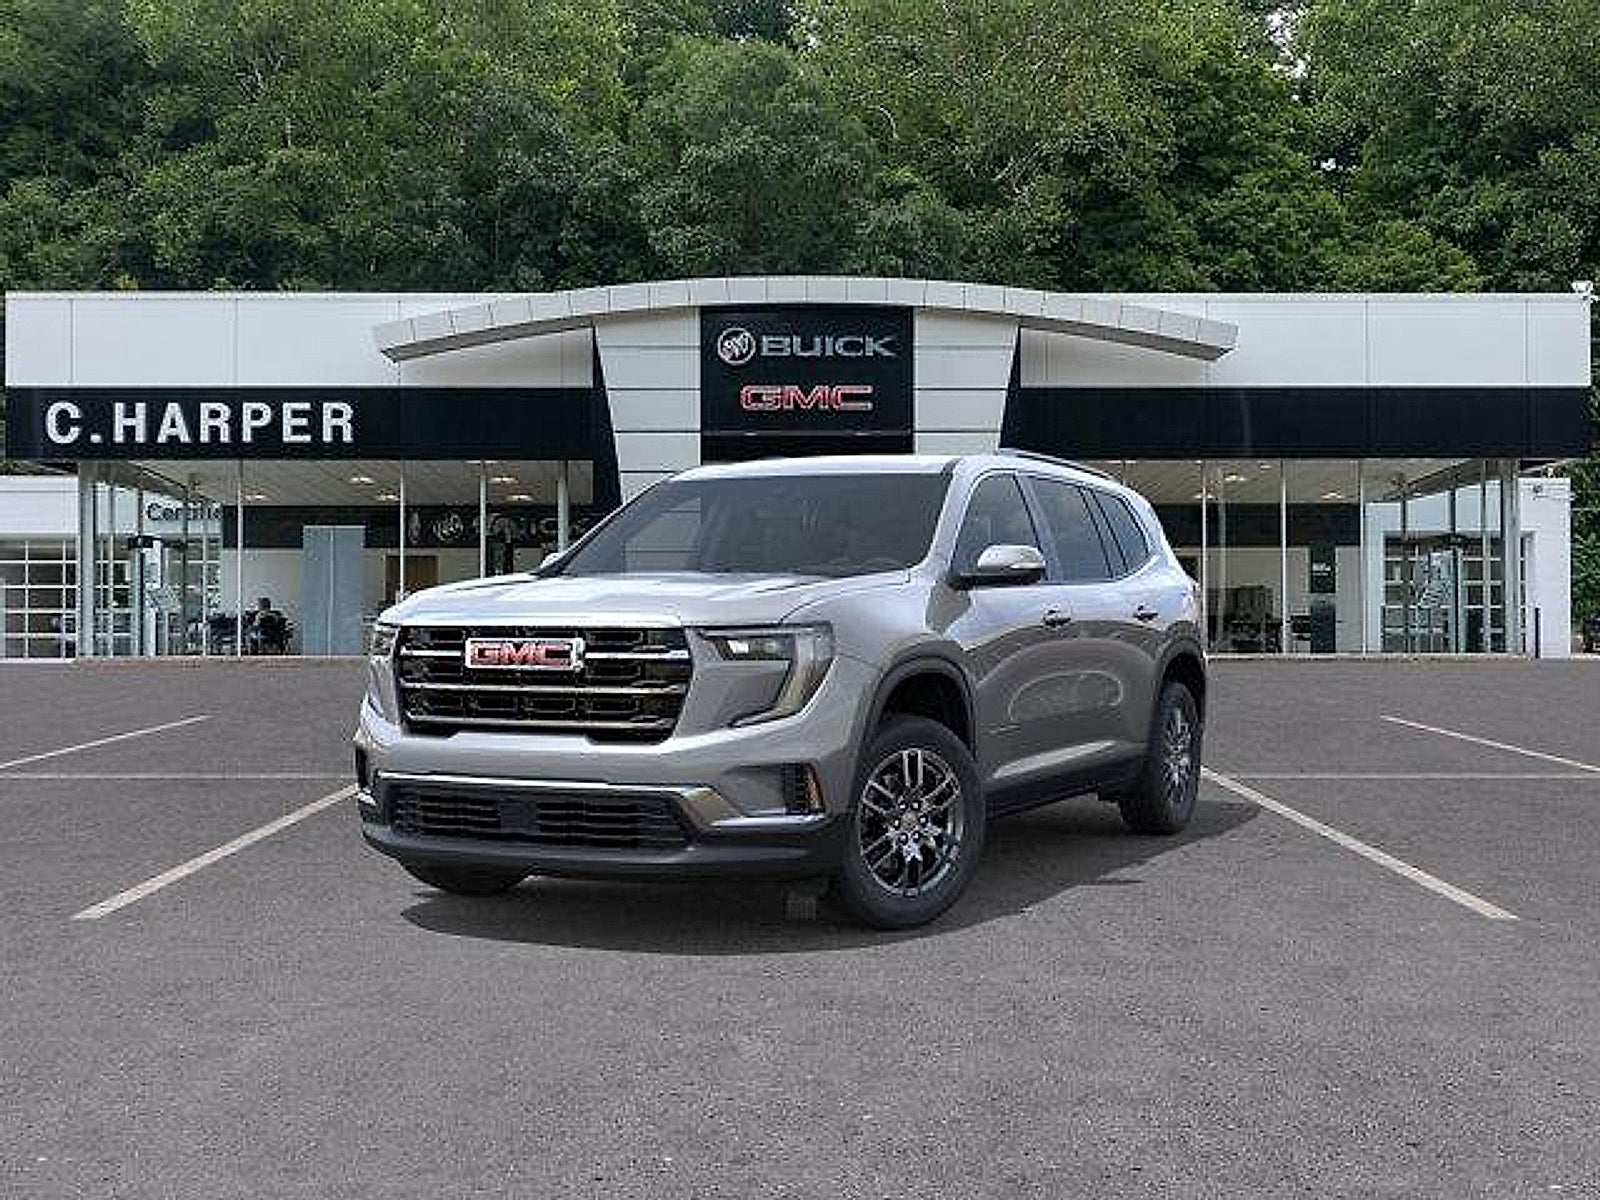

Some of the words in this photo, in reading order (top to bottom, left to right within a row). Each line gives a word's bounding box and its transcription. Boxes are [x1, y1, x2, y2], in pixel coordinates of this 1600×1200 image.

[761, 334, 896, 356] BUICK
[741, 384, 874, 411] GMC
[470, 642, 570, 666] GMC
